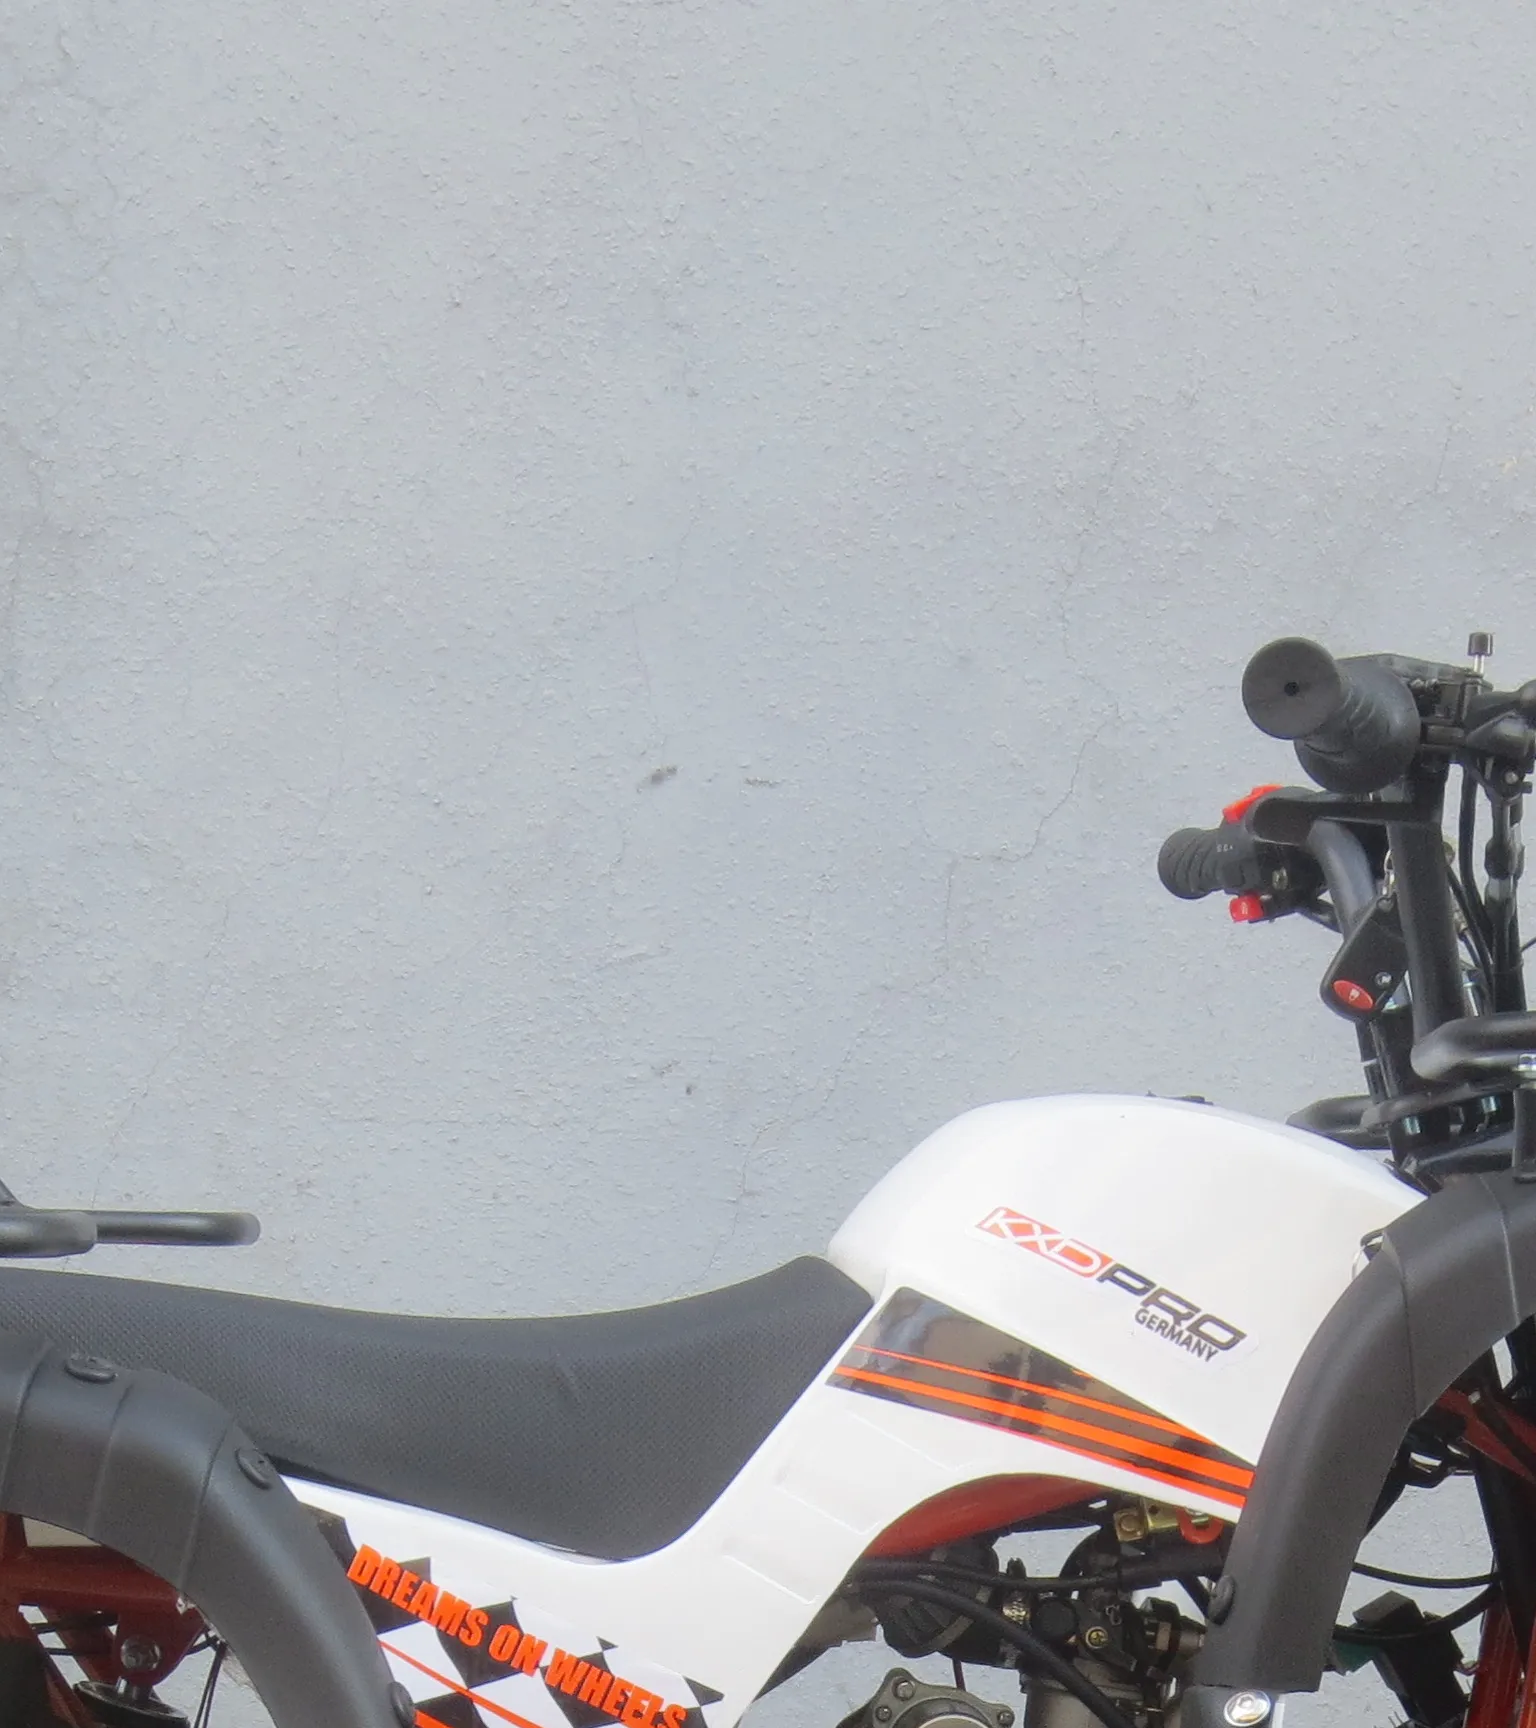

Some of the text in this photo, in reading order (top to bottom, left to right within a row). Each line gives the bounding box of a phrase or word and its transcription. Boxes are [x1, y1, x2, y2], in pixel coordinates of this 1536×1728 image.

[1134, 1307, 1219, 1363] GERMANY
[346, 1543, 490, 1648] DREAMS
[488, 1623, 549, 1678] ON
